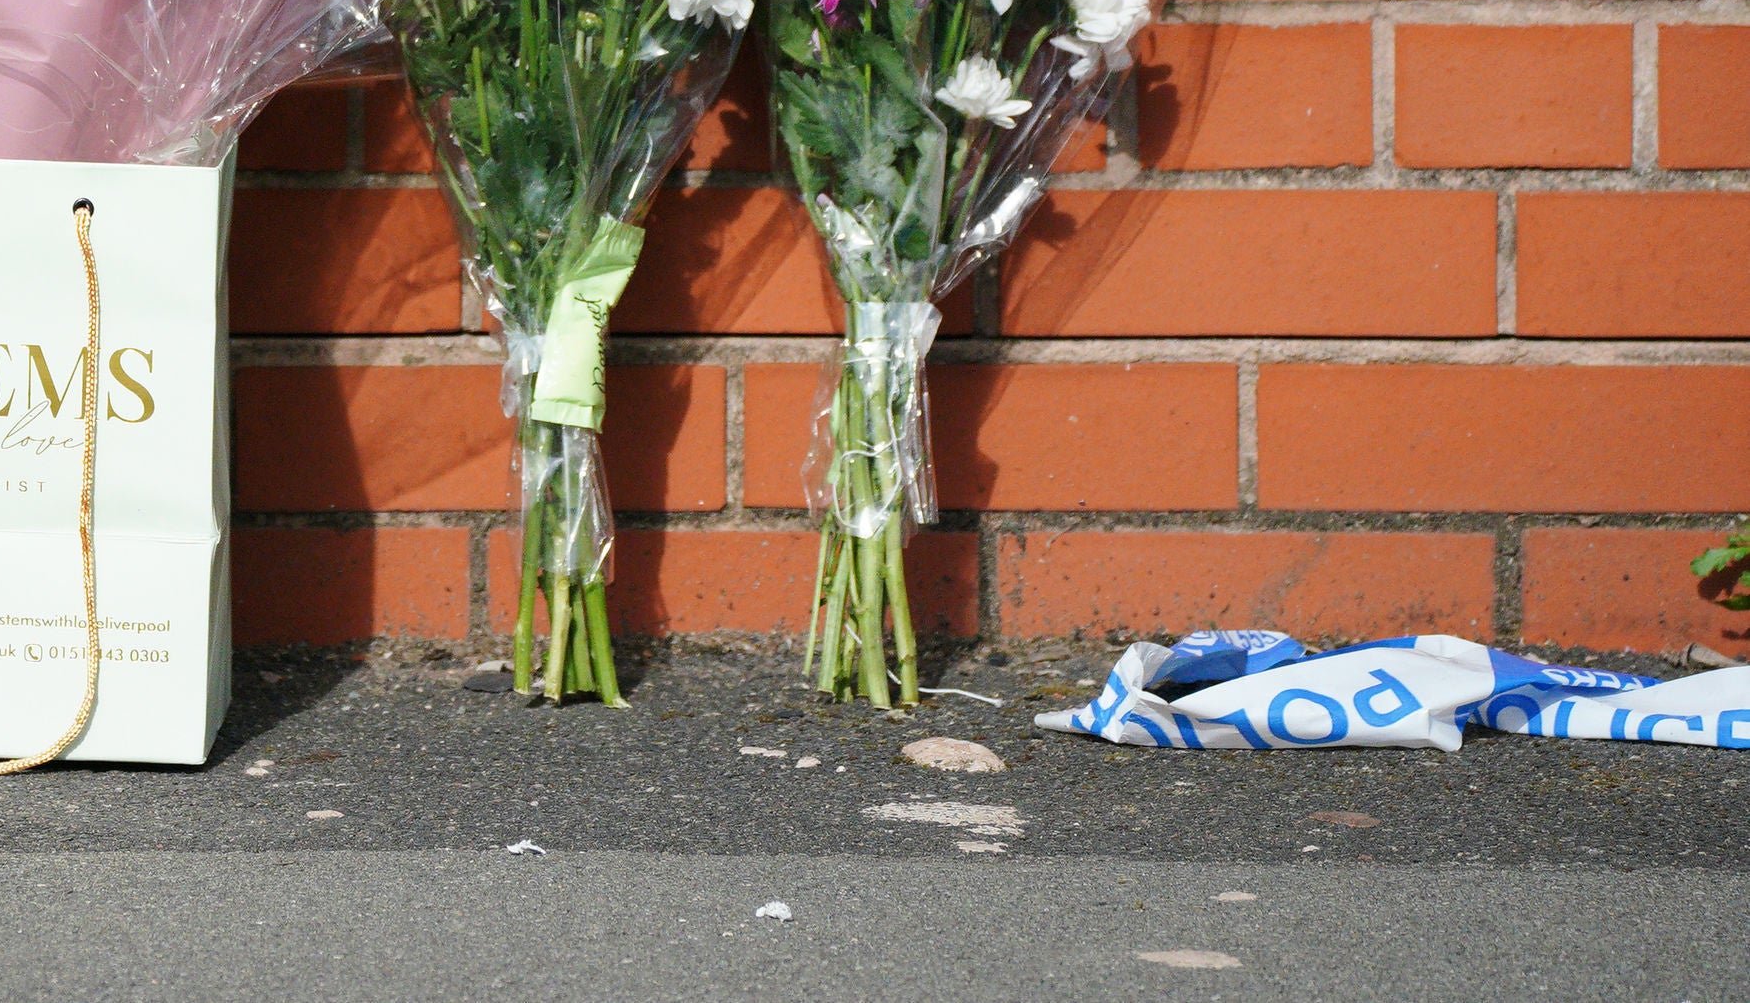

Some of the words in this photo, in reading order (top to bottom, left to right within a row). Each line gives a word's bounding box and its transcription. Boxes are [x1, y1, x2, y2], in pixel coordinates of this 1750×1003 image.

[1, 400, 85, 456] love
[0, 614, 171, 634] stemswithloeliverpool
[49, 645, 87, 660] 0151
[129, 648, 170, 664] 0303
